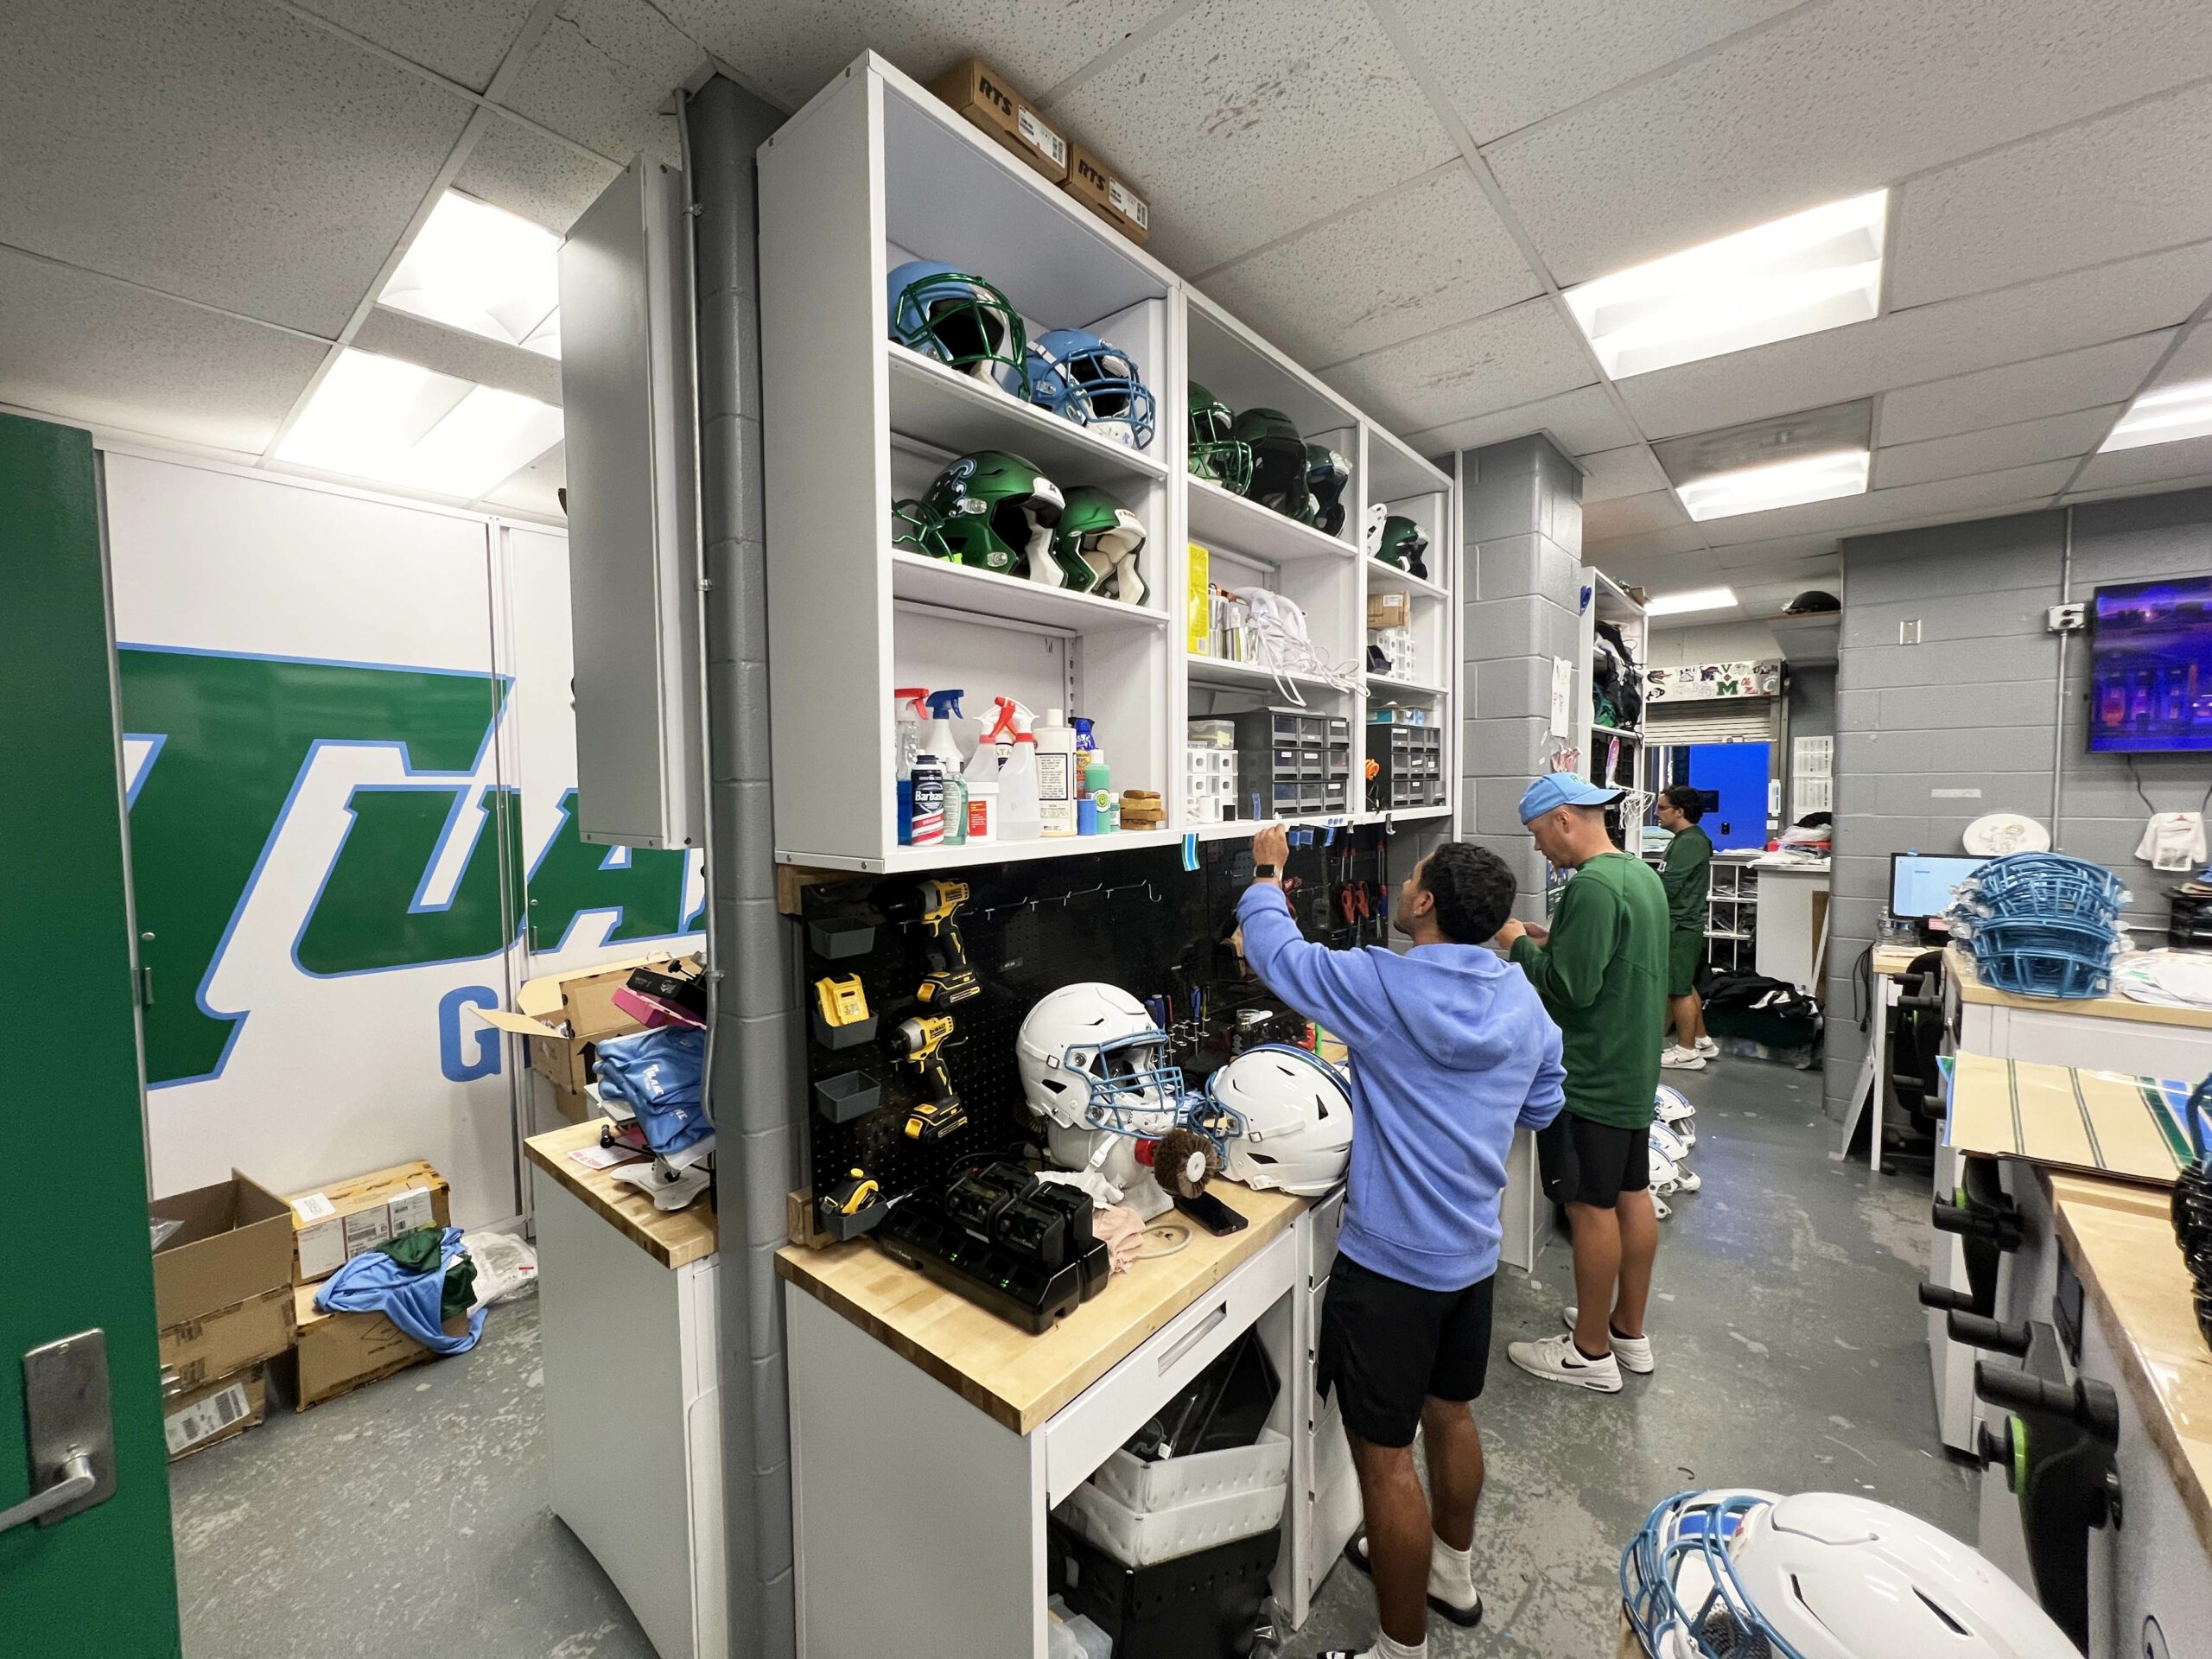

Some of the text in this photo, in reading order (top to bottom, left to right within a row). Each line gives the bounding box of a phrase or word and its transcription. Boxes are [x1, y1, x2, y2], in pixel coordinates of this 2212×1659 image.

[979, 77, 1012, 116] RTS
[1078, 160, 1106, 191] RTS
[1716, 680, 1738, 696] M
